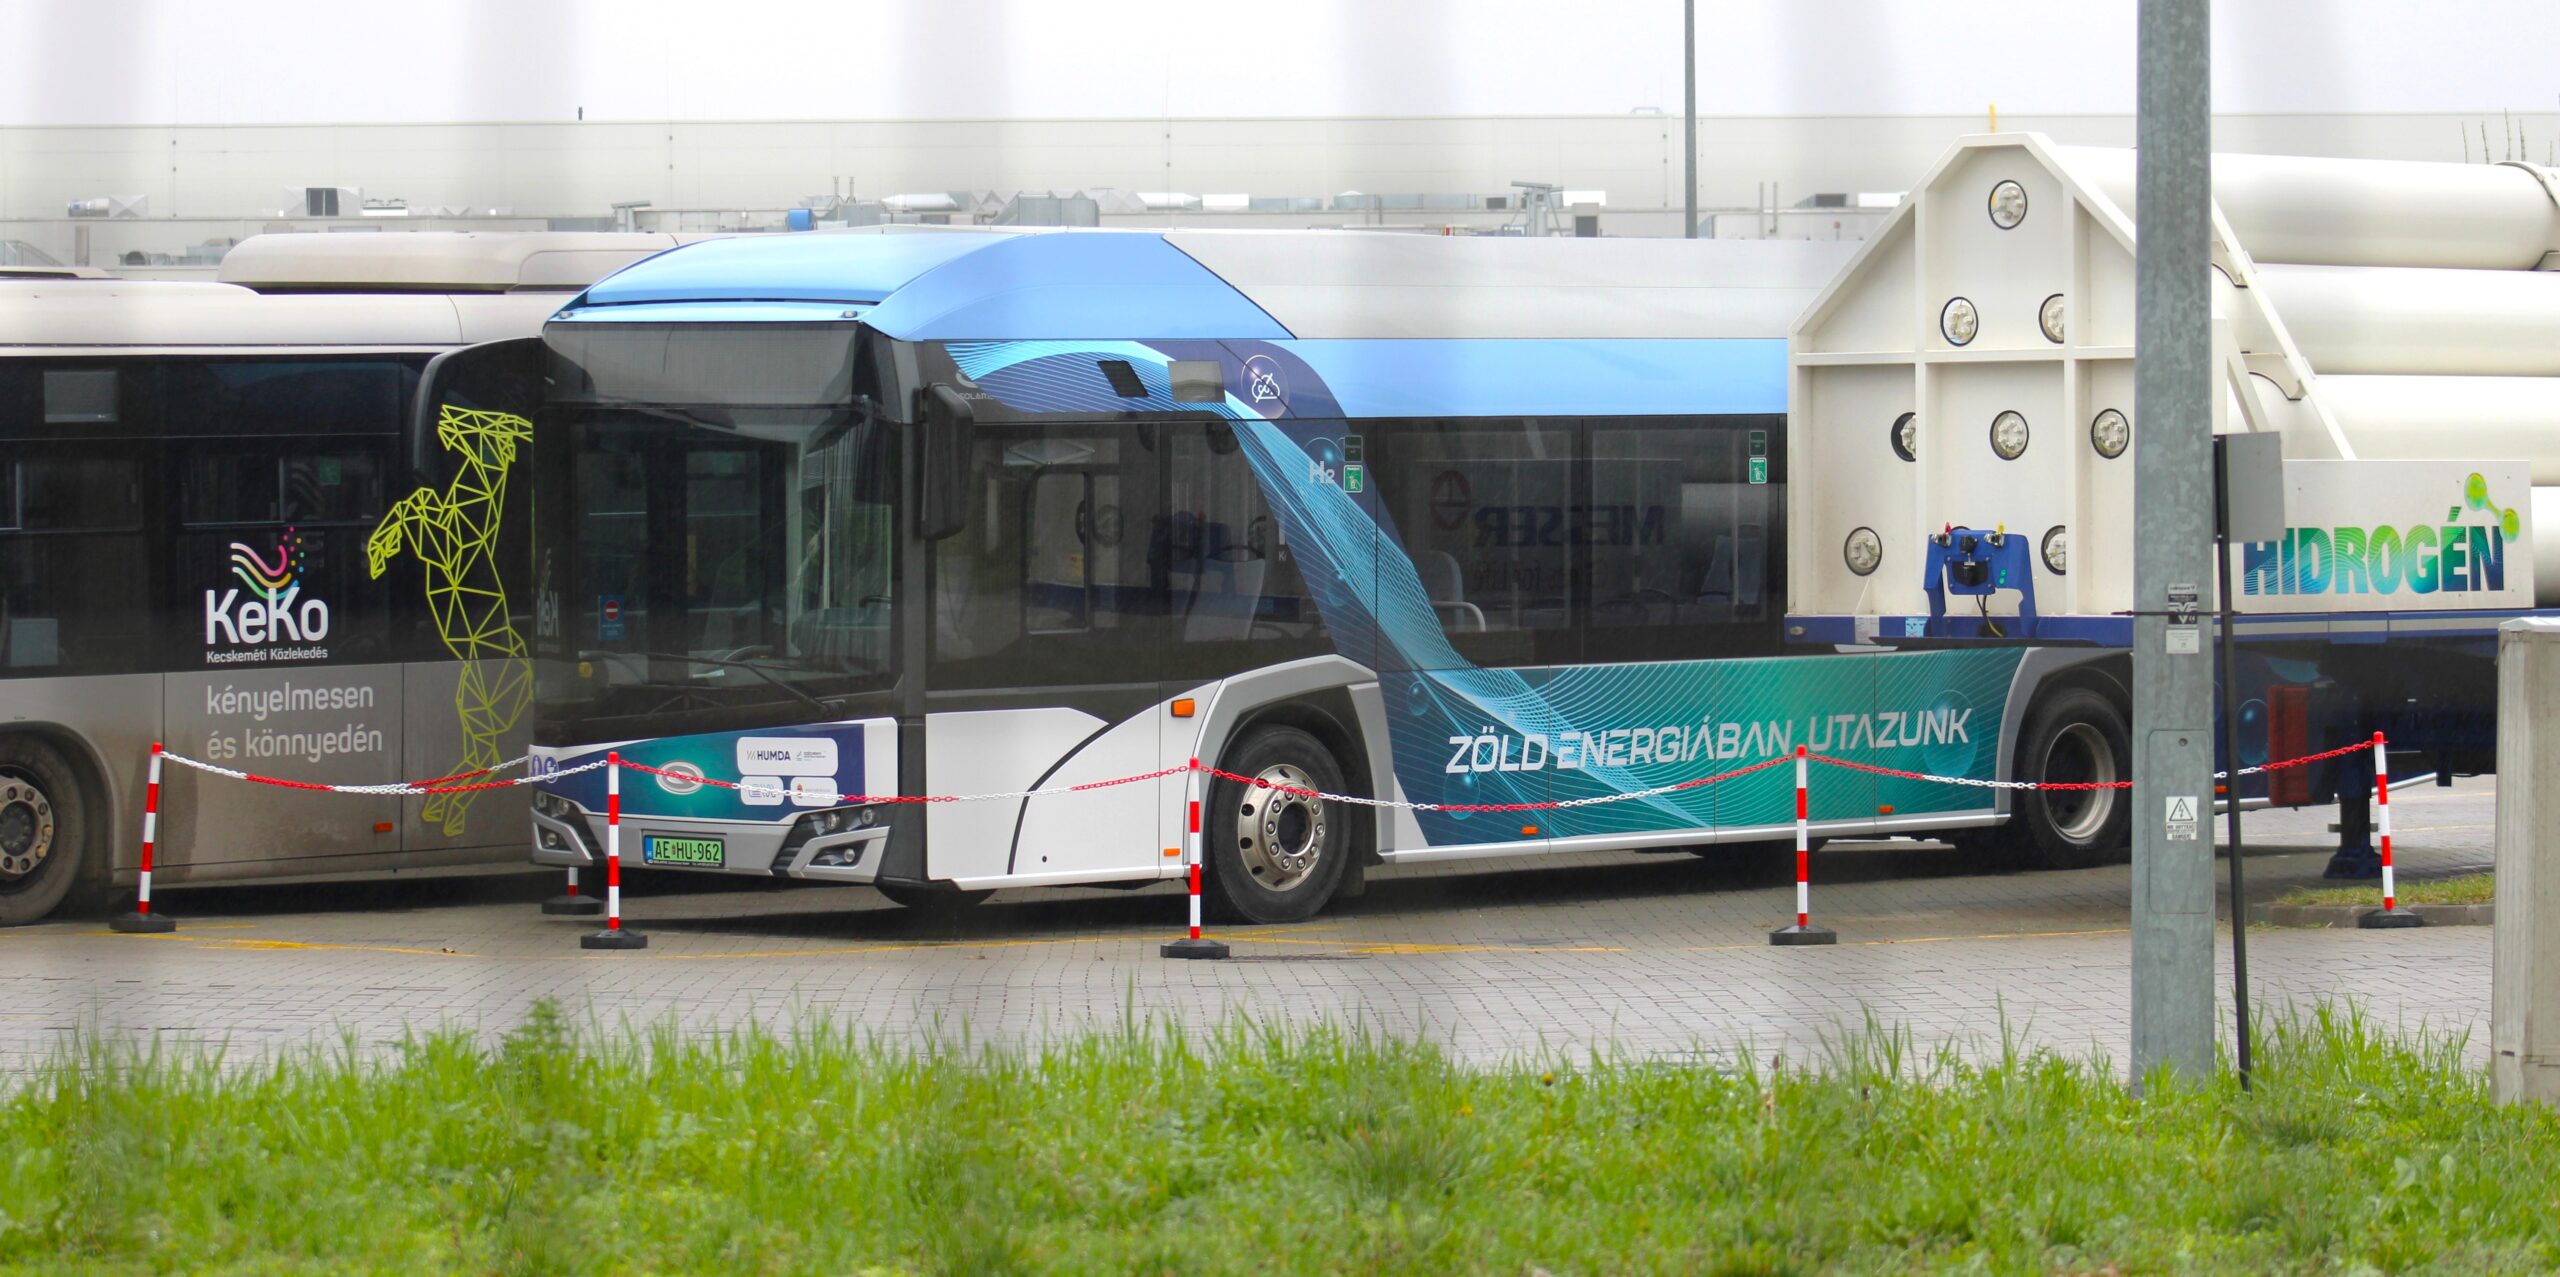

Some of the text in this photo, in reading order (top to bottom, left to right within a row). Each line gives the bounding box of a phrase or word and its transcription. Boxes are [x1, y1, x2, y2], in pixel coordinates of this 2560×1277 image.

[2243, 506, 2505, 595] HIDROGÉN
[206, 587, 329, 645] KeKo
[206, 647, 328, 663] Kecskeméti Közlekedés
[207, 682, 374, 721] kényelmesen
[207, 723, 382, 763] és könnyedén
[757, 750, 791, 761] HUMDA
[1446, 708, 1972, 773] ZÖLD ENERGIÁBAN UTAZUNK
[655, 841, 670, 859] AE
[676, 842, 720, 861] HU-962
